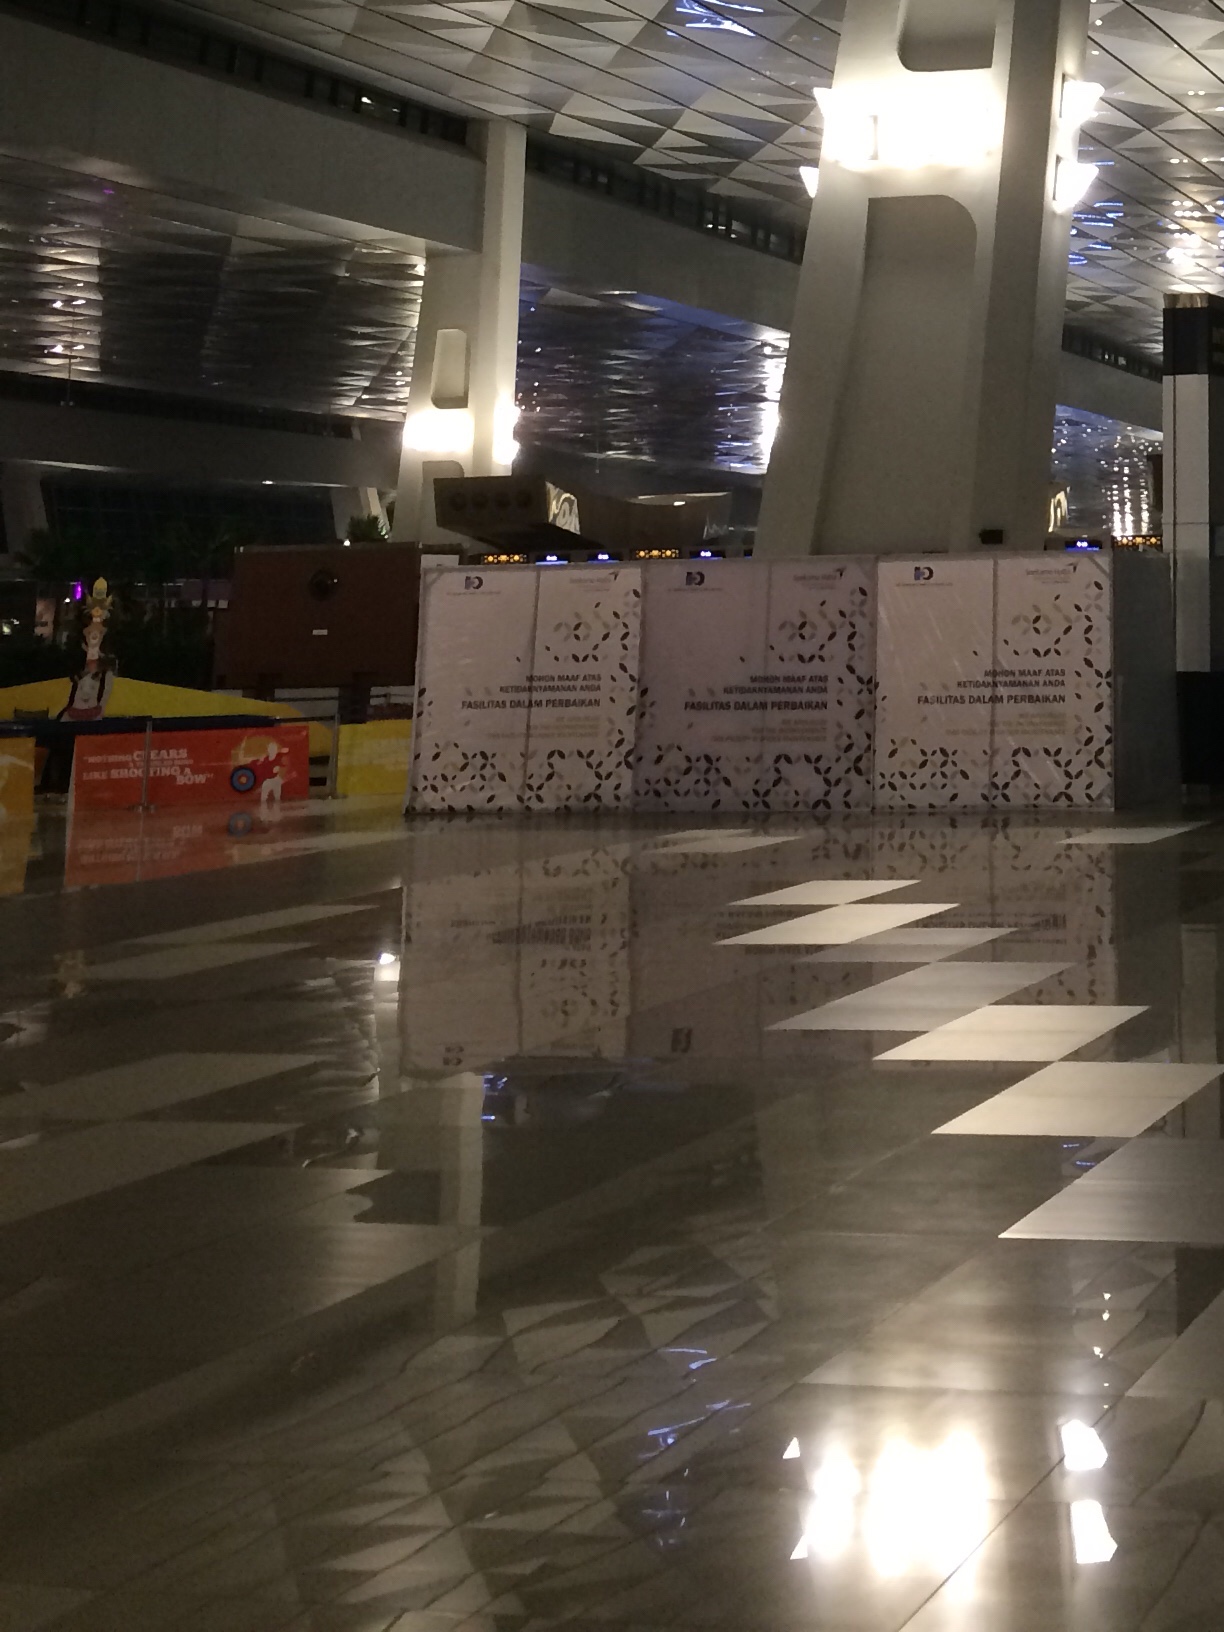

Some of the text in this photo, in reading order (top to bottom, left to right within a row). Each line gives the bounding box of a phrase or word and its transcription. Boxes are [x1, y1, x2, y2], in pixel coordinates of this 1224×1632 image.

[461, 698, 601, 710] FASILITAS DALAM PERBAIKAN
[918, 694, 1065, 705] FASILITAS DALAM PERBAIKAN
[684, 701, 828, 711] FASILITAS DALAM PERBAIKAN
[133, 749, 187, 761] CEARS
